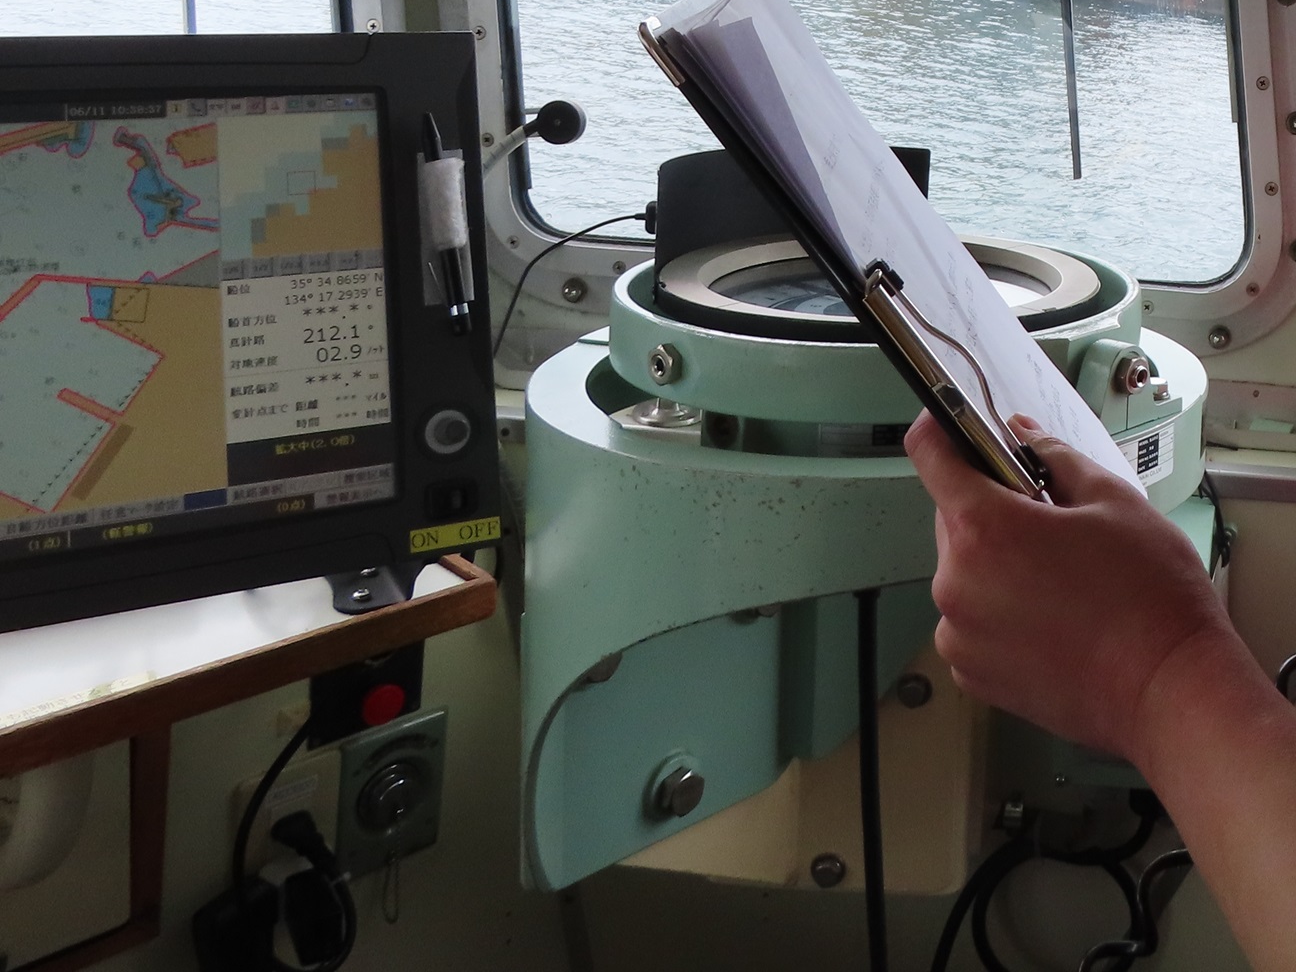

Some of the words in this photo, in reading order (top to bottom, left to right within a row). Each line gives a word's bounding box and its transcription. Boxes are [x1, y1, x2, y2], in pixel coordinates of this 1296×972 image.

[374, 272, 383, 283] N
[376, 287, 383, 297] E
[303, 325, 360, 345] 212.1
[317, 343, 362, 363] 02.9
[411, 530, 439, 549] ON
[459, 520, 499, 541] OFF
